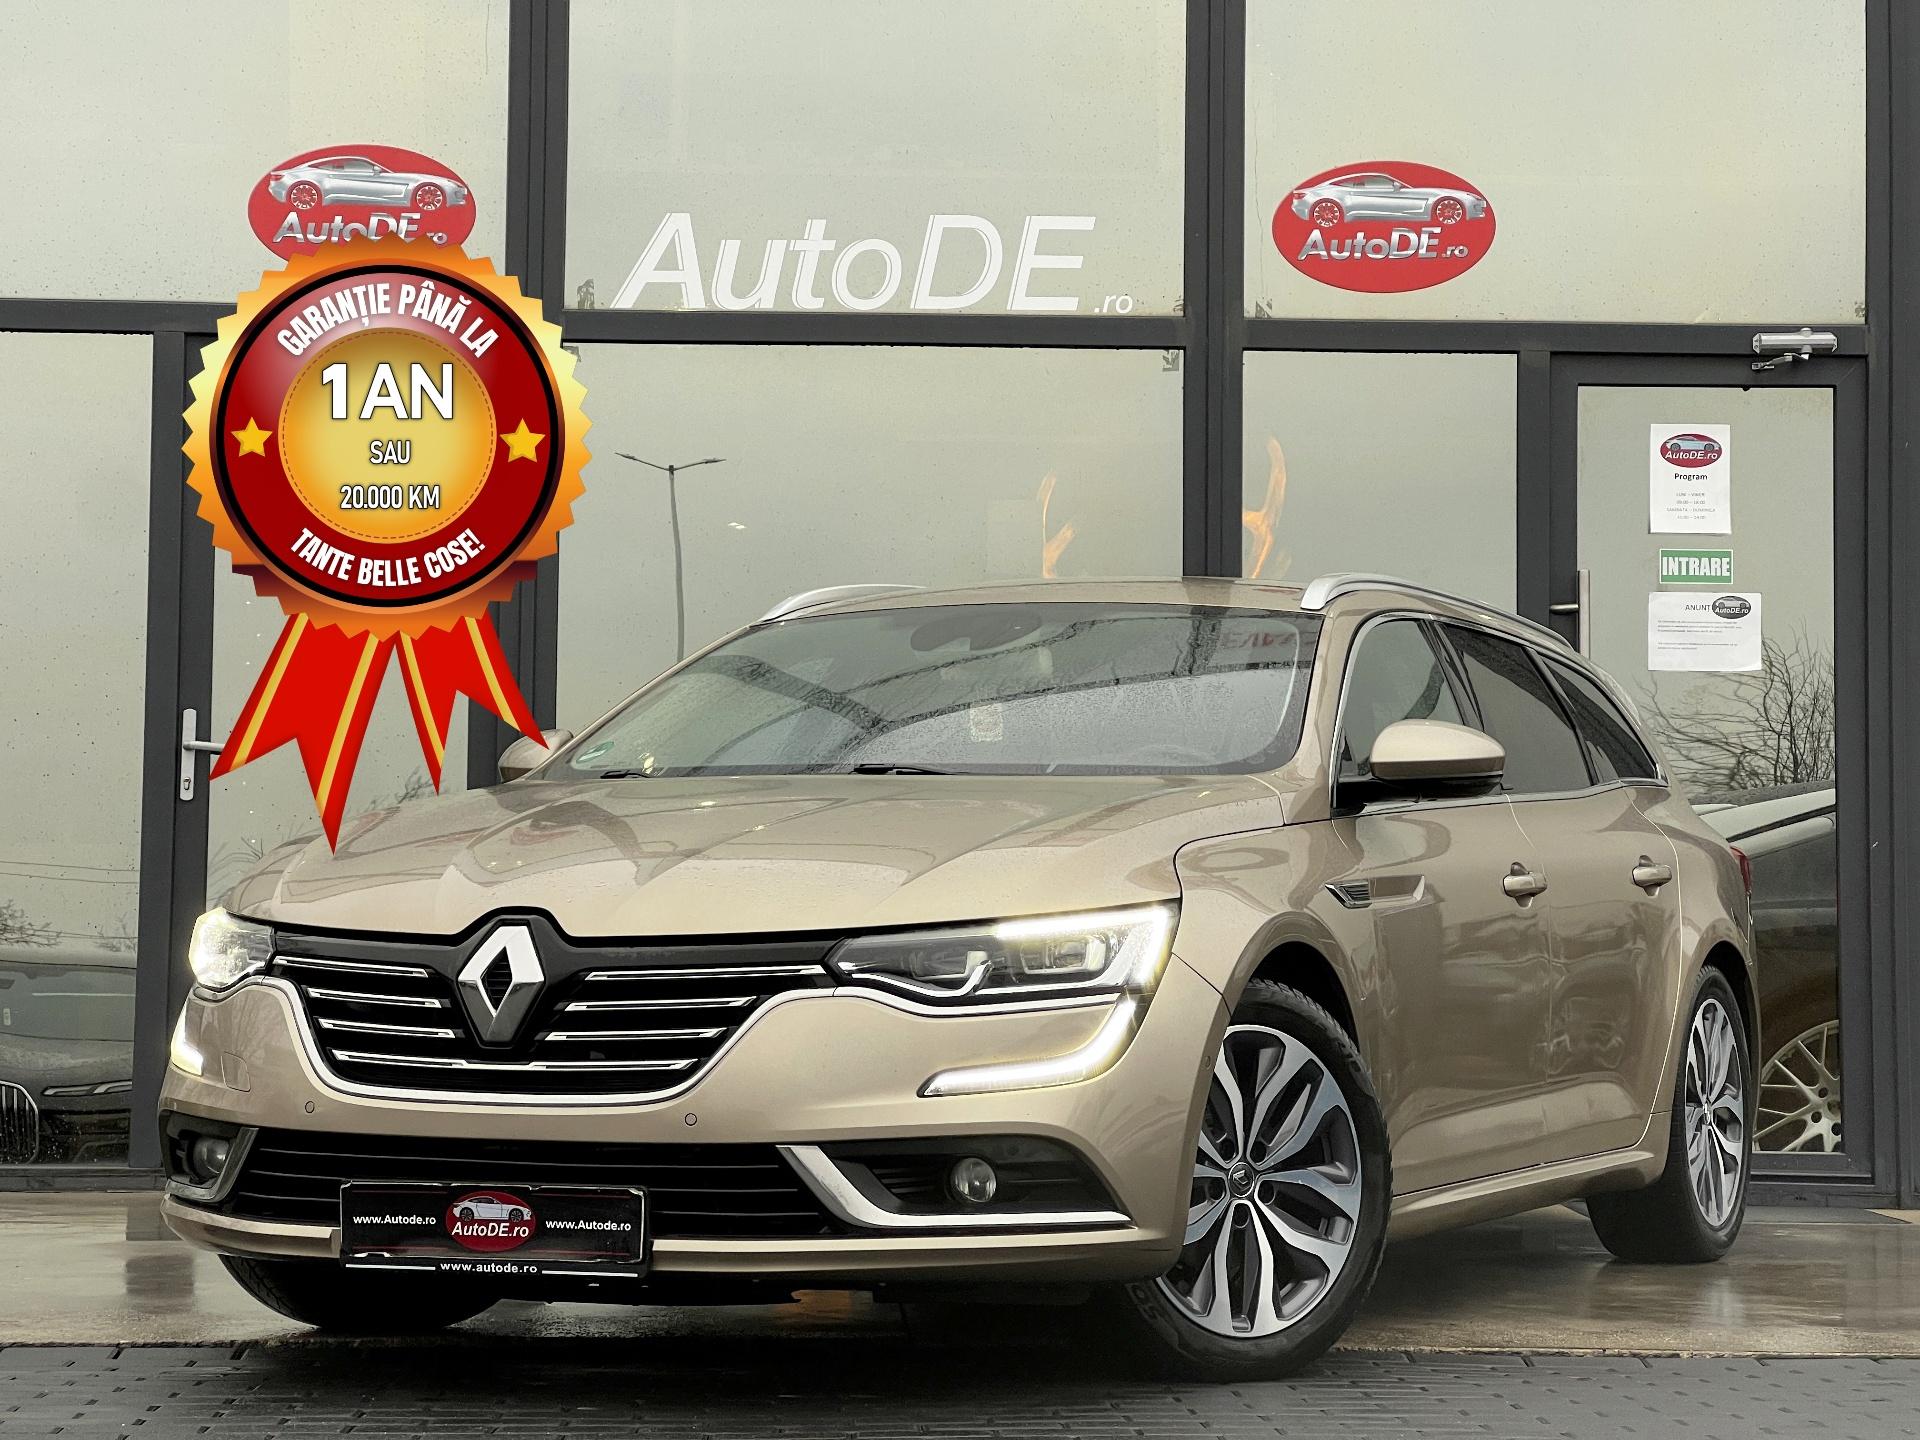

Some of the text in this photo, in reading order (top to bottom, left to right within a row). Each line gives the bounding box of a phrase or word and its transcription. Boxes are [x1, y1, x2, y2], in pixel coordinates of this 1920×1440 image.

[1665, 450, 1718, 460] AutoDE.ro
[1674, 472, 1708, 482] Program
[1662, 556, 1731, 577] INTRARE
[352, 1214, 437, 1226] www.Autode.ro
[545, 1219, 632, 1232] www.Autode.ro
[451, 1221, 530, 1238] AutoDE.ro
[440, 1261, 538, 1274] www.autode.ro
